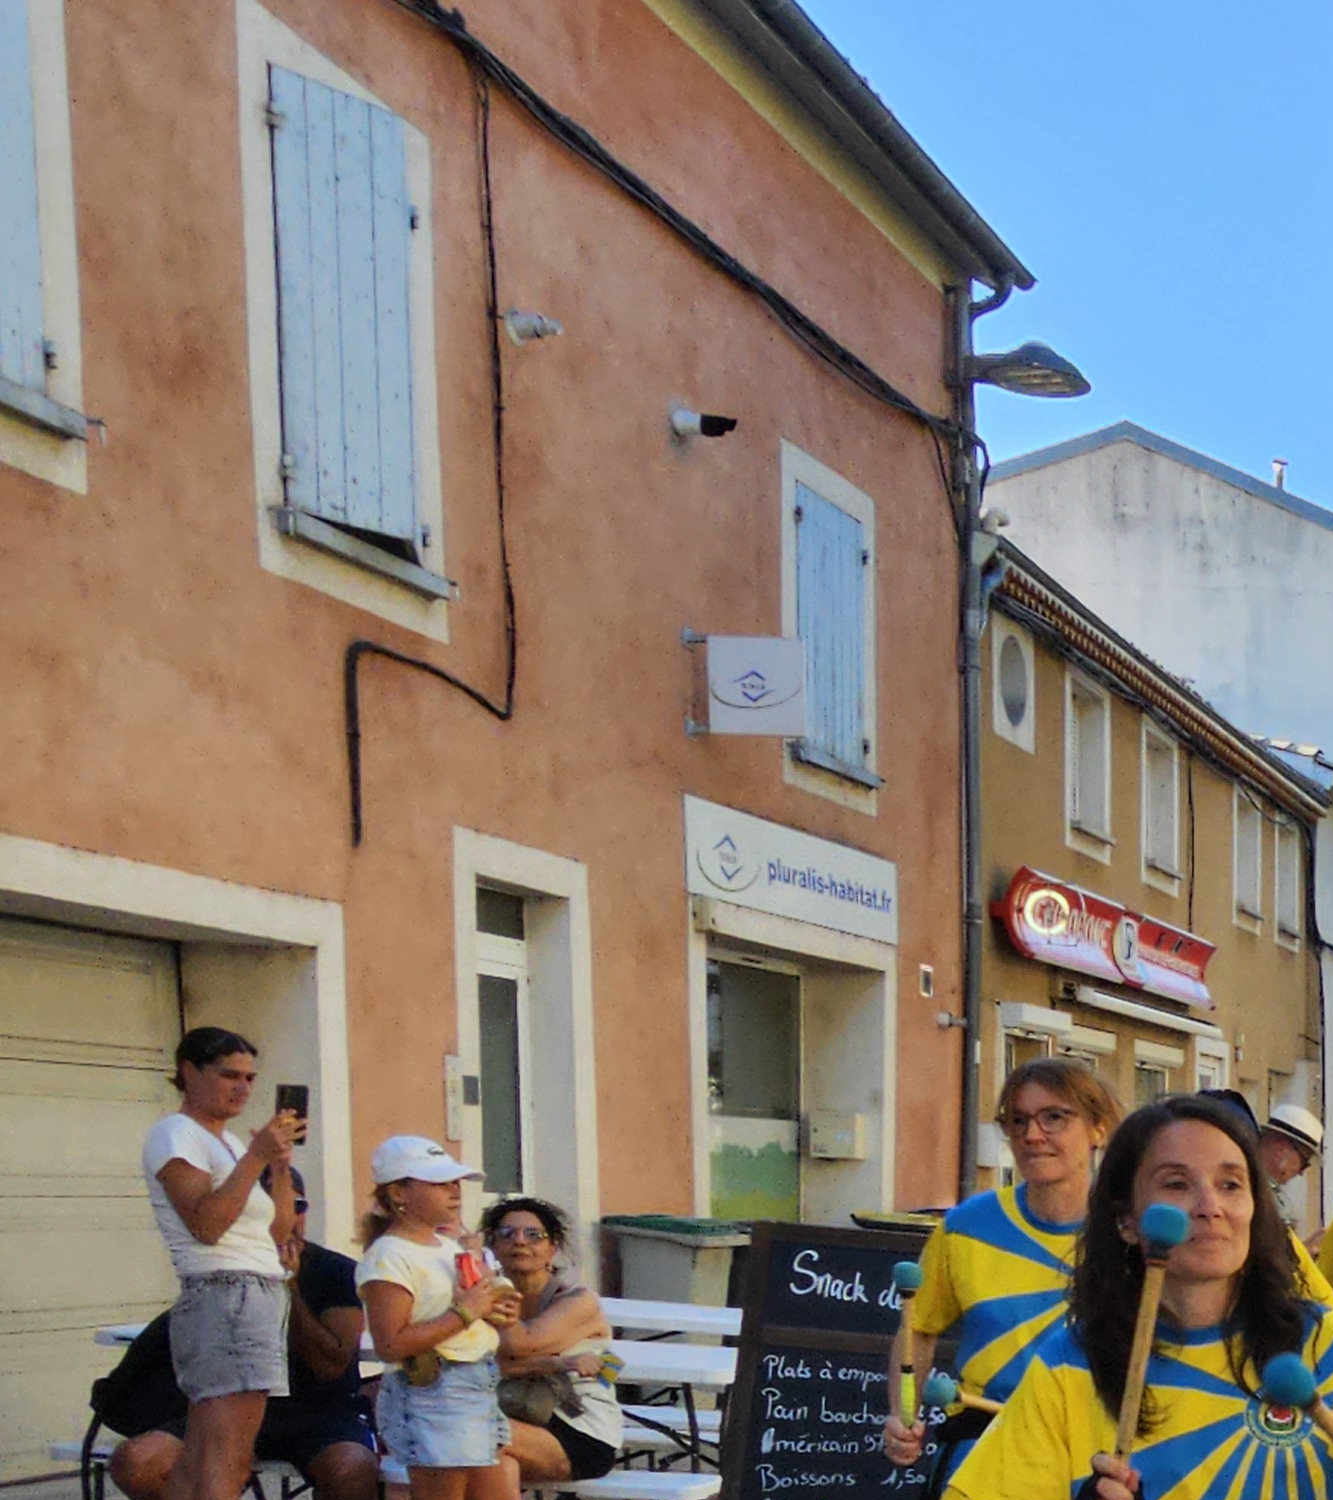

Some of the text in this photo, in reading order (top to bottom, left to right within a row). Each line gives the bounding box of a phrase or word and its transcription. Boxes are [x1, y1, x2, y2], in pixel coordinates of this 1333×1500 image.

[767, 858, 893, 914] pluralis-habitat.fr
[789, 1249, 869, 1303] Snack
[762, 1354, 889, 1391] Plats à empo
[755, 1463, 856, 1492] Boissons
